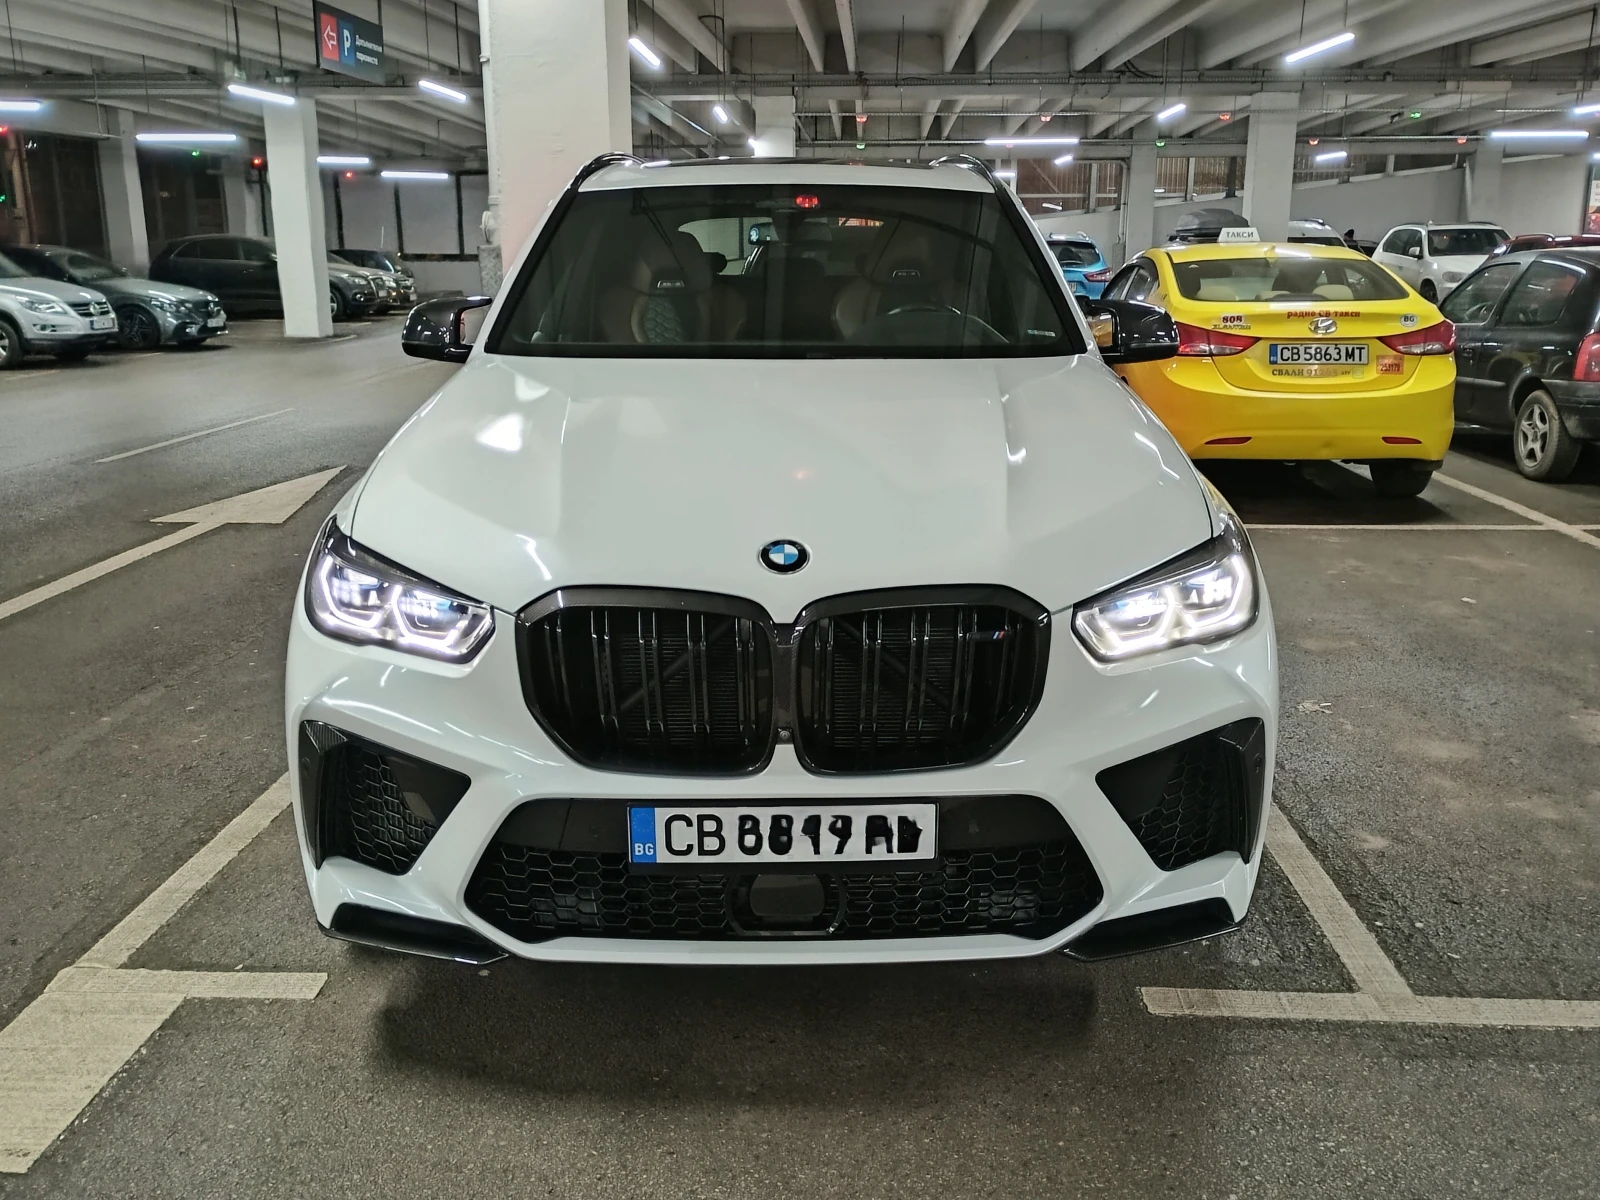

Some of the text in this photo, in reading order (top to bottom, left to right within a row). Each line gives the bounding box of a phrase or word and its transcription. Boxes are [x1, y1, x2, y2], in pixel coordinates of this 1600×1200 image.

[343, 29, 351, 57] P
[1222, 315, 1243, 324] 808
[1403, 315, 1415, 323] BG
[1280, 346, 1301, 362] CB
[1303, 346, 1342, 362] 5863
[1345, 346, 1365, 362] MT
[664, 814, 726, 857] CB
[634, 843, 654, 856] BG
